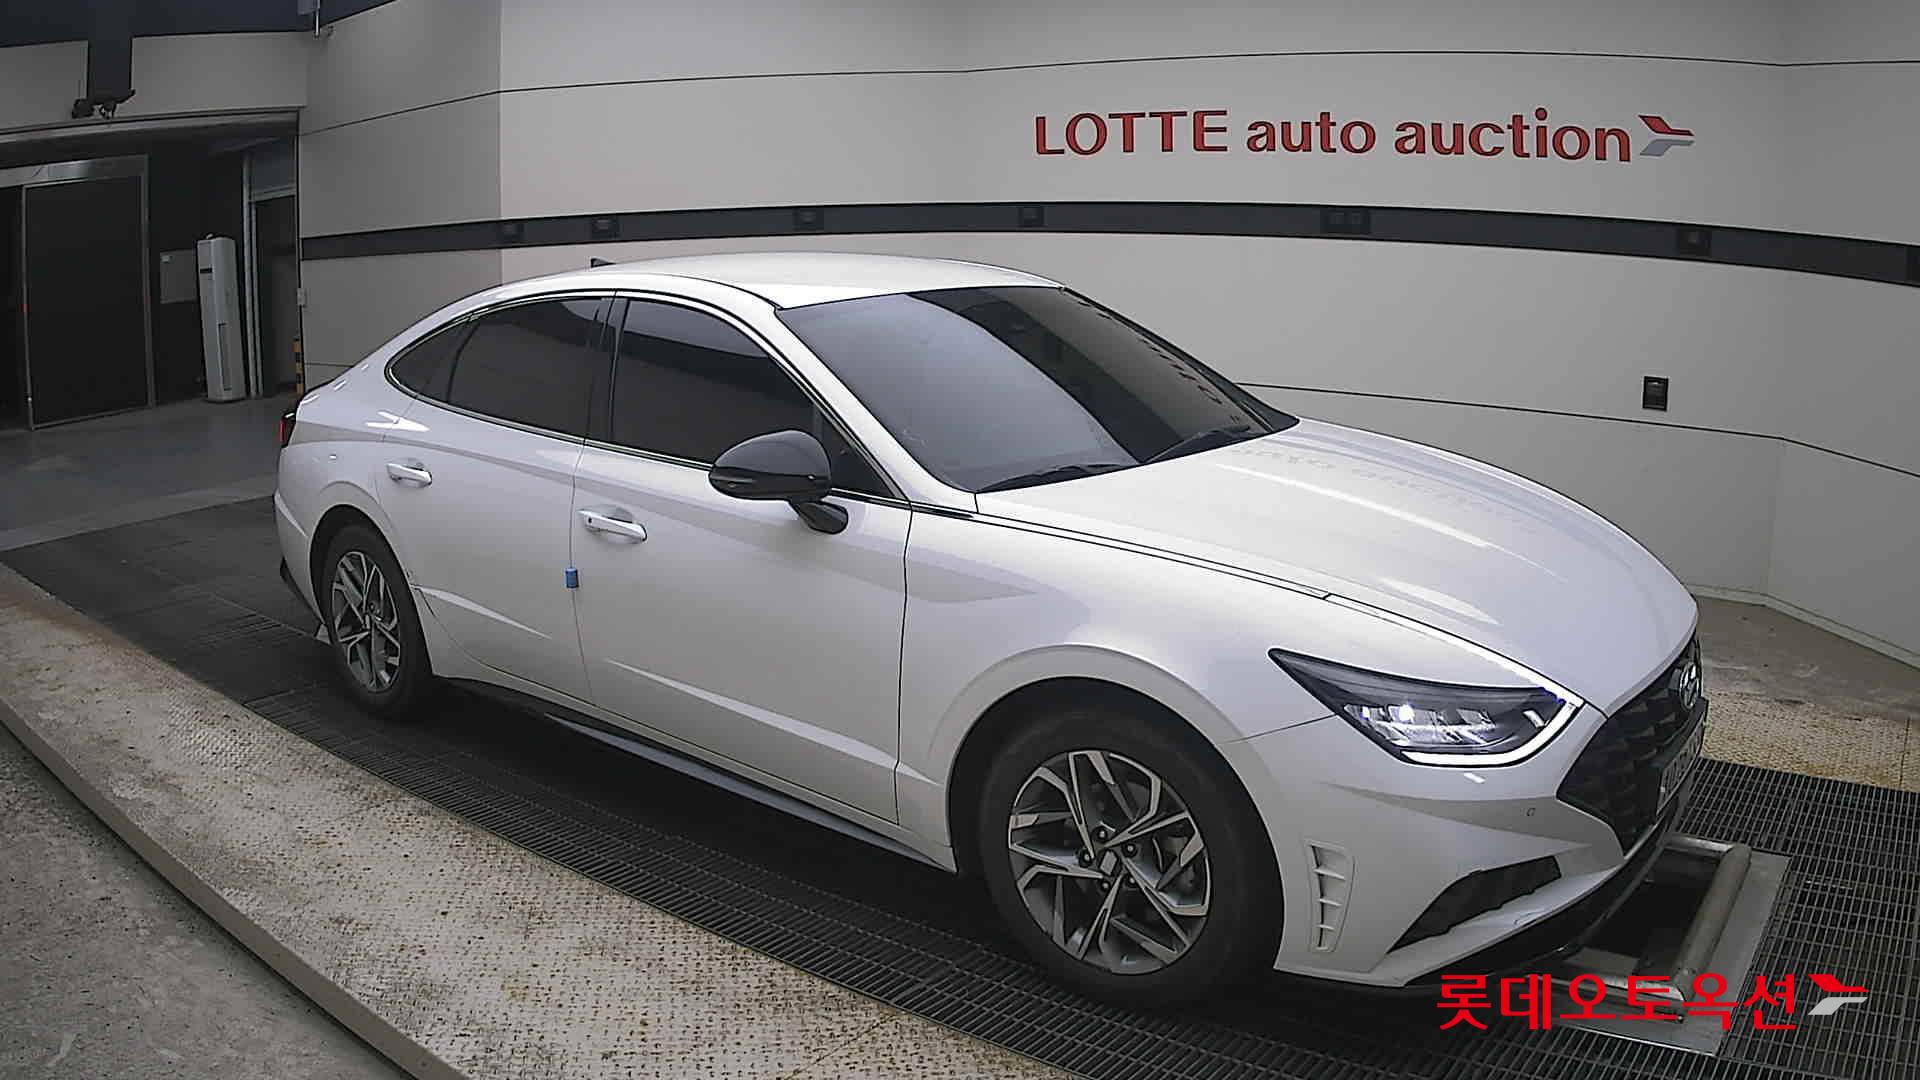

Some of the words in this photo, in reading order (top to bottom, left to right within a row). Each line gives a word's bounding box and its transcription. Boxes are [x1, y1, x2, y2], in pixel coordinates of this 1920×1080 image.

[1036, 110, 1228, 155] LOTTE
[1246, 112, 1375, 154] auto
[1394, 108, 1631, 162] auction
